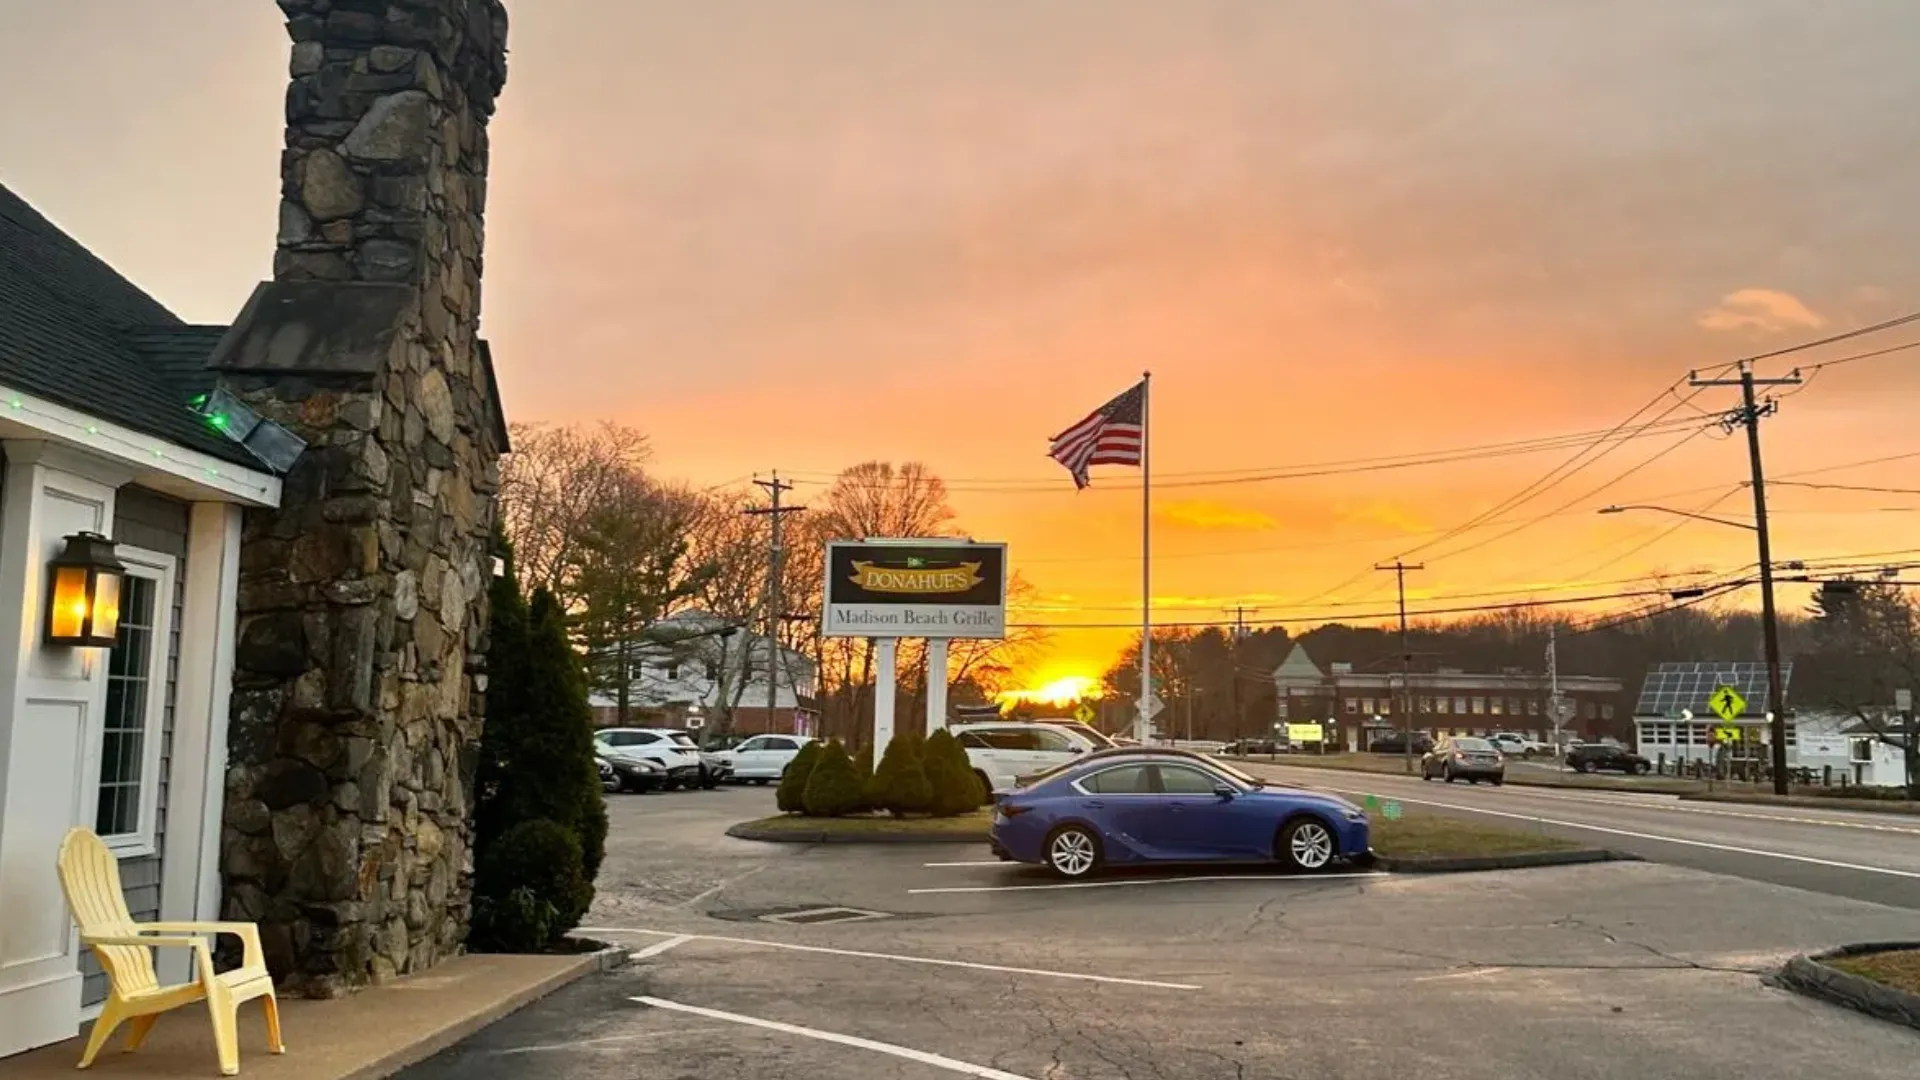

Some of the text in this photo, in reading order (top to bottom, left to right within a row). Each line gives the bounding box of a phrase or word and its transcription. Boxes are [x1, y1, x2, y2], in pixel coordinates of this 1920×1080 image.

[866, 571, 968, 589] DONAHUE'S
[836, 609, 996, 626] Madison Beach Grille
